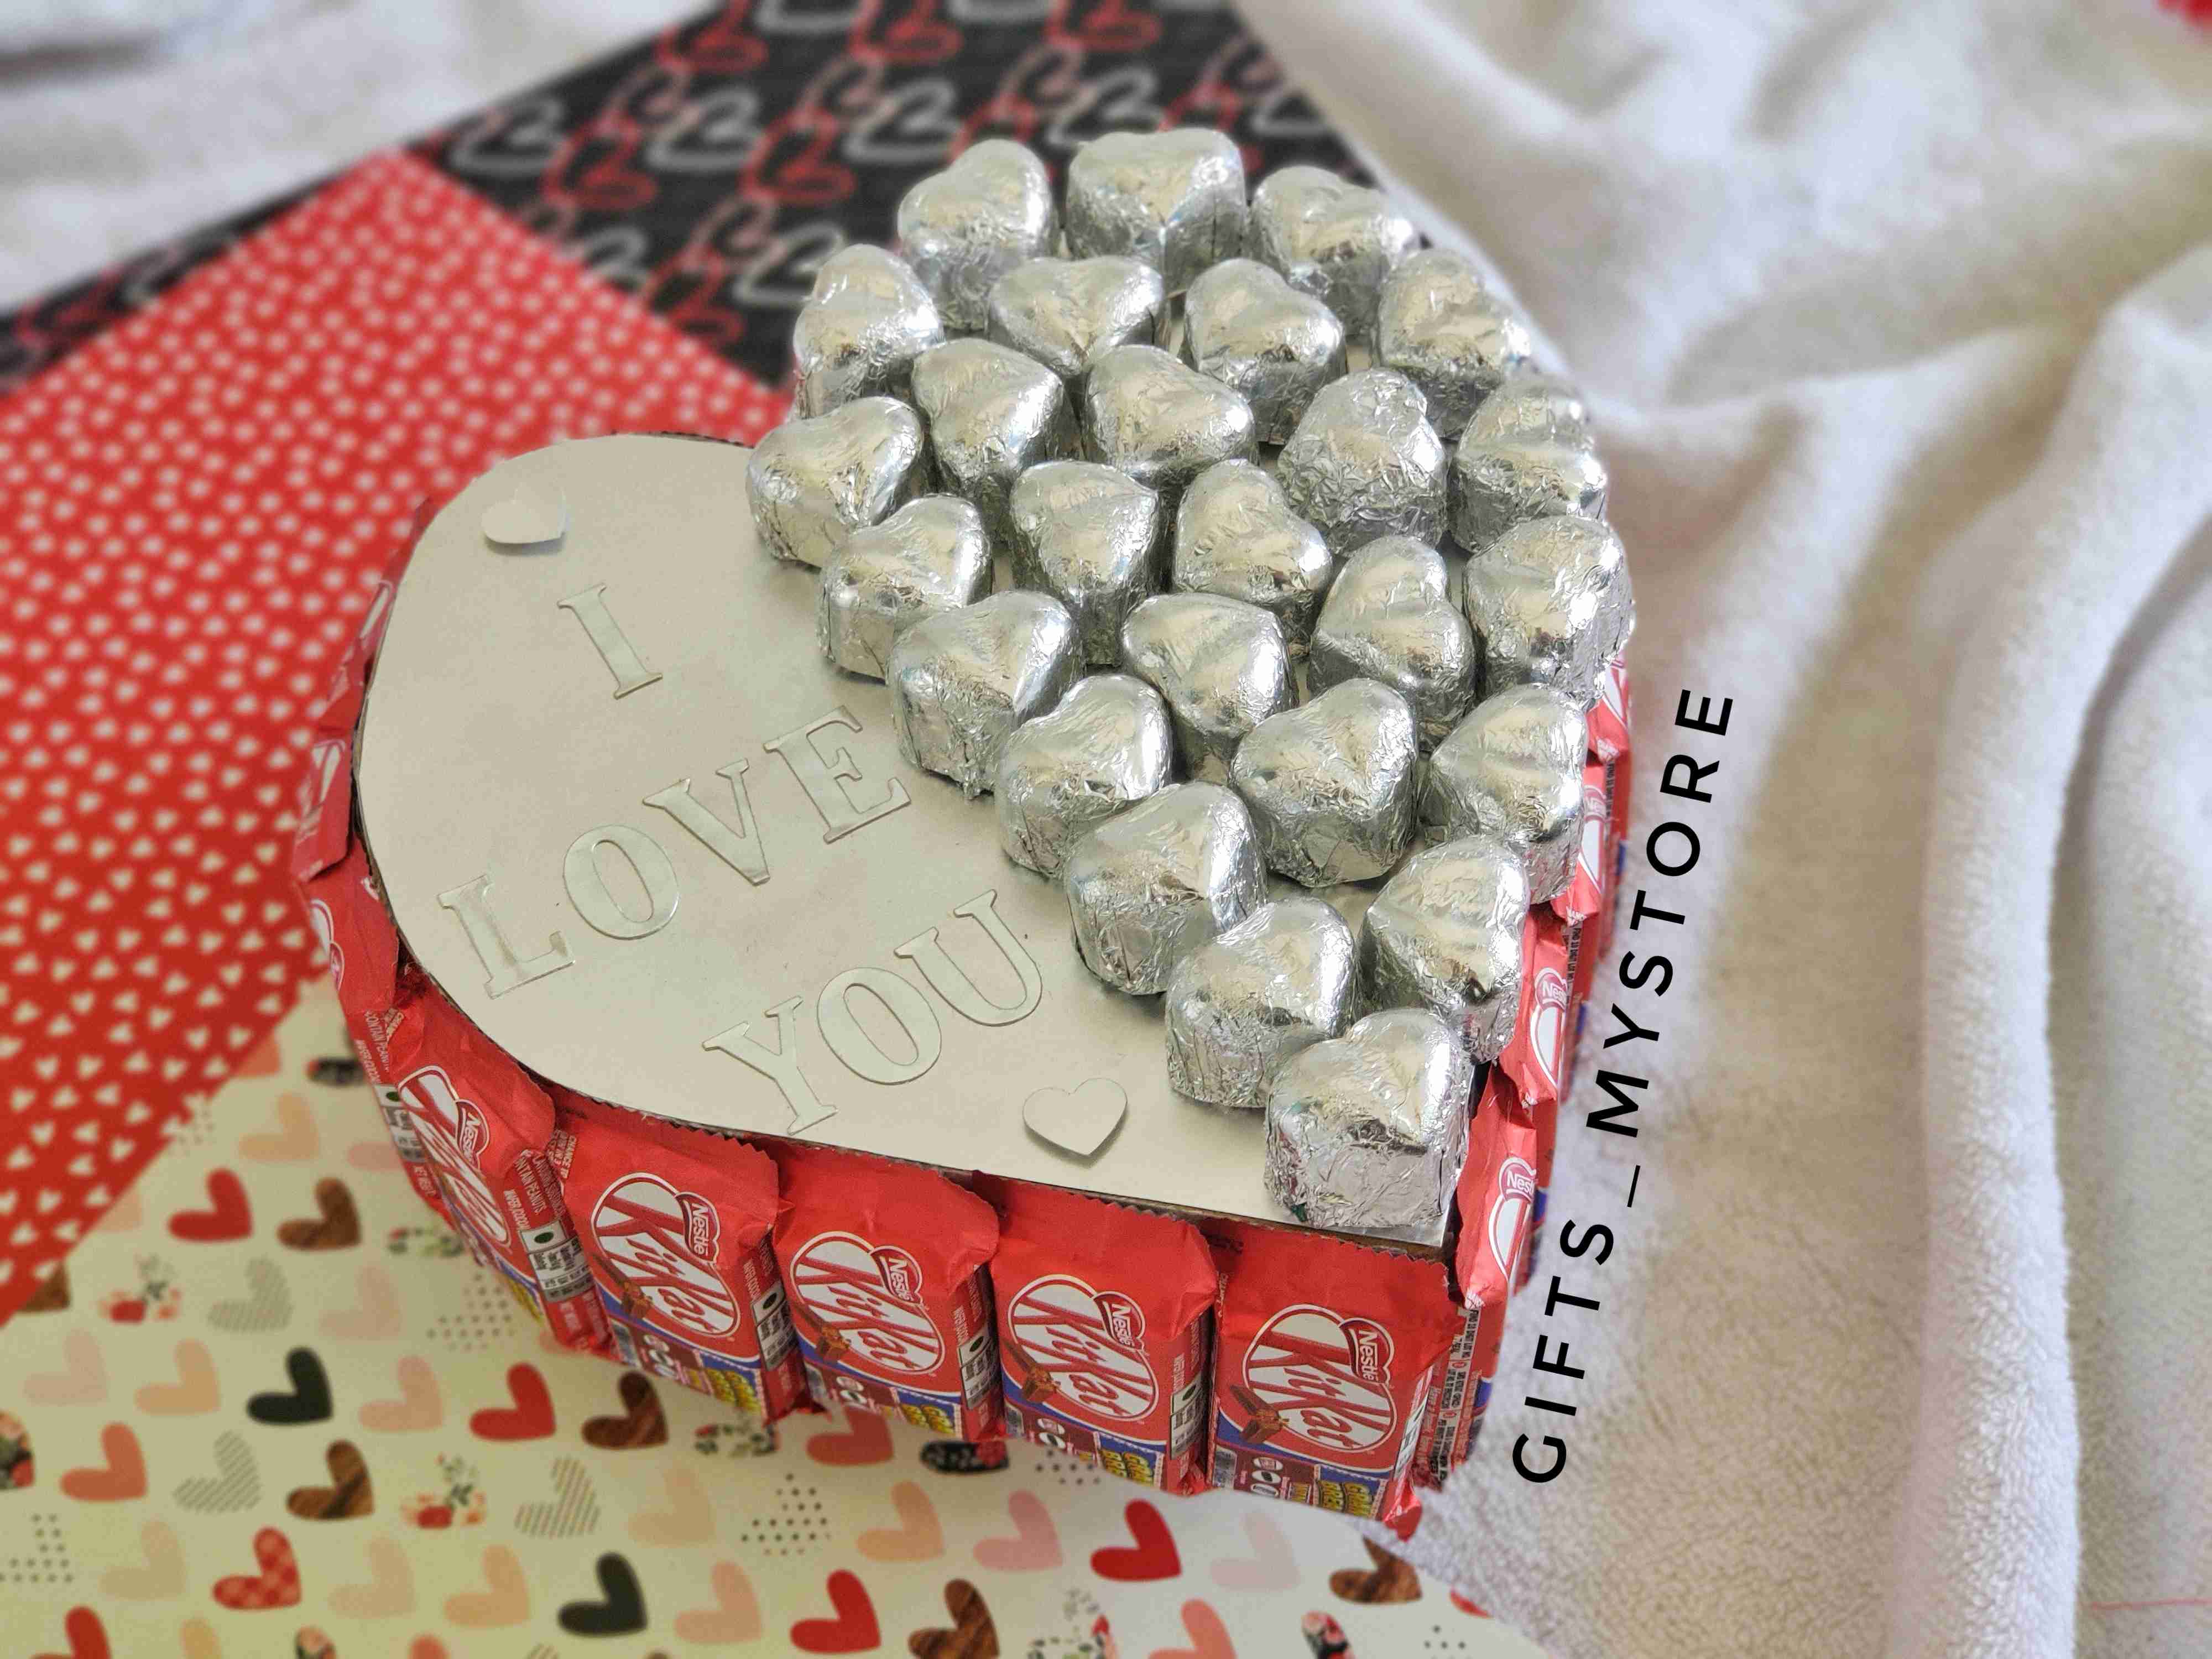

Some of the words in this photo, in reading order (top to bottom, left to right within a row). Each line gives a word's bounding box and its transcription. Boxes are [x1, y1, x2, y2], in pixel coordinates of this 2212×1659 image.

[557, 583, 664, 700] I
[436, 706, 911, 999] LOVE
[702, 888, 1043, 1135] YOU
[1542, 980, 1567, 1006] Nes
[1506, 1170, 1536, 1196] Nest
